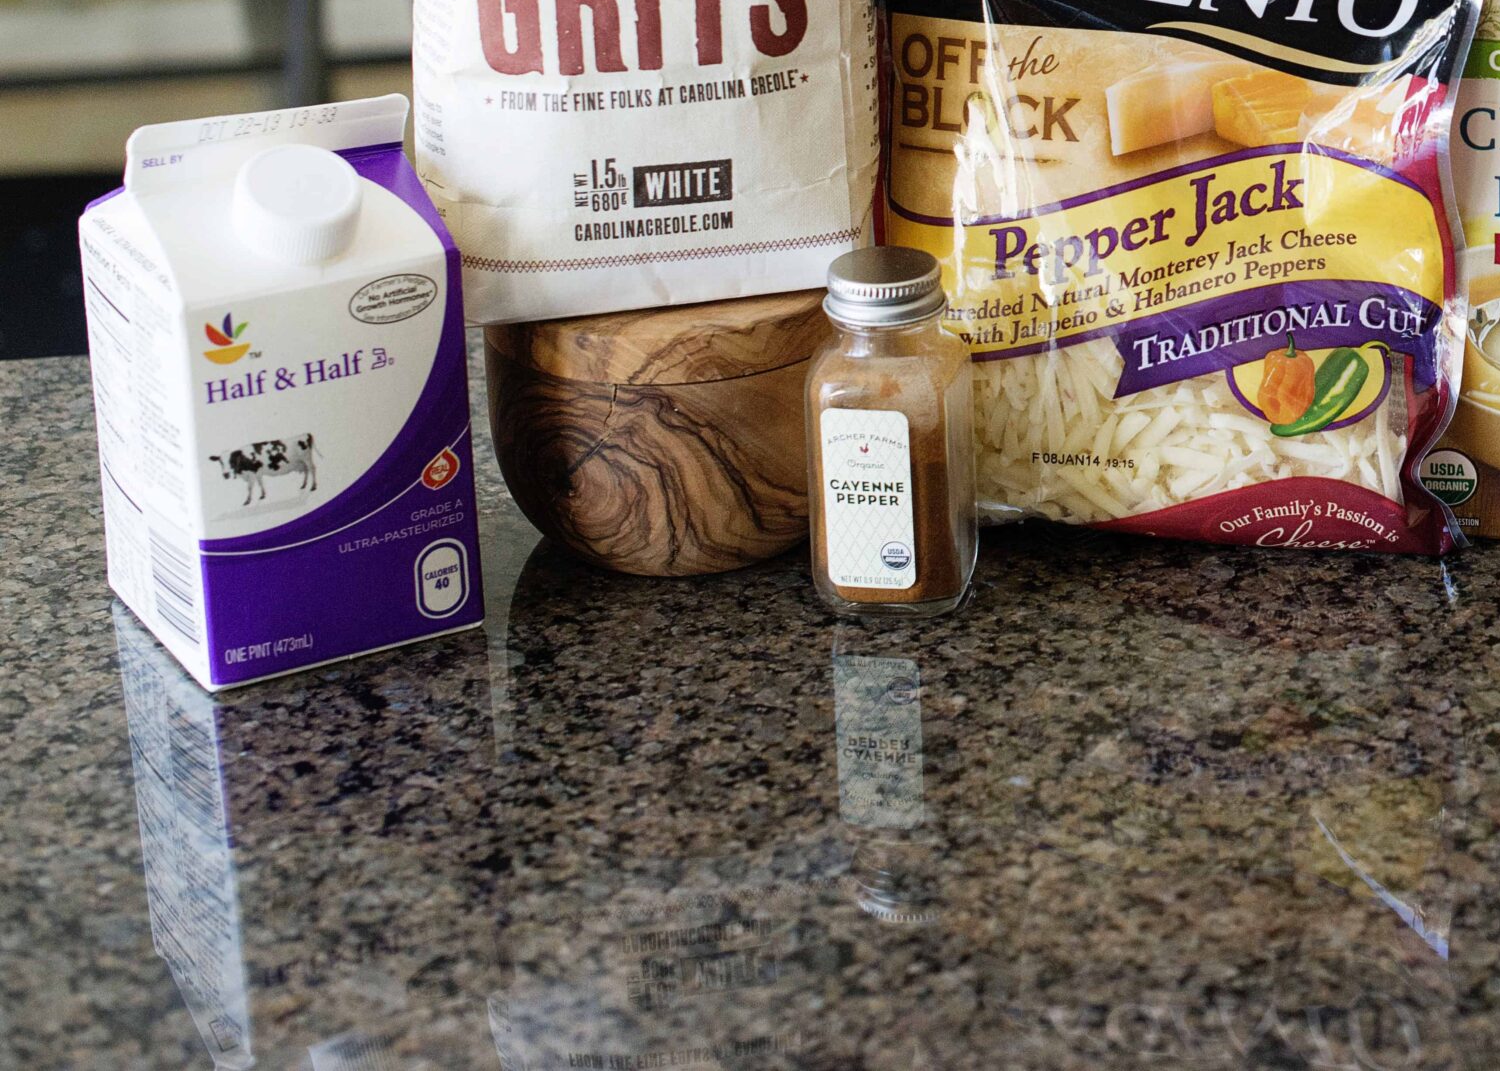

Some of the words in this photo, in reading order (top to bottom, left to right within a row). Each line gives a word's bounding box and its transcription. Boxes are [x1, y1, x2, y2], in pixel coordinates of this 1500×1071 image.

[902, 33, 998, 84] OFF
[1007, 35, 1060, 82] the
[501, 90, 538, 111] FROM
[542, 92, 568, 112] THE
[574, 89, 605, 111] FINE
[611, 87, 652, 109] FOLKS
[658, 88, 673, 106] AT
[680, 79, 746, 103] CAROLINA
[142, 158, 166, 169] SELL
[170, 154, 183, 165] BY
[573, 173, 588, 187] WT
[645, 167, 720, 200] WHITE
[574, 191, 589, 207] NET
[574, 211, 733, 241] CAROLINACREOLE.COM
[989, 204, 1175, 284] Pepper
[1185, 160, 1306, 245] Jack
[944, 294, 1024, 322] hredded
[1118, 247, 1219, 290] Monterey
[1225, 234, 1272, 266] Jack
[1280, 229, 1358, 249] Cheese
[960, 322, 1004, 346] with
[1011, 309, 1098, 344] Jalapeño
[1105, 298, 1125, 318] &
[1133, 270, 1236, 314] Habanero
[1244, 255, 1326, 283] Peppers
[1134, 302, 1350, 371] TRADITIONAL
[1359, 296, 1428, 341] CUT
[205, 370, 267, 404] Half
[274, 367, 296, 391] &
[304, 350, 363, 385] Half
[827, 433, 866, 445] ARCHER
[847, 460, 885, 470] Organic
[1032, 453, 1040, 463] F
[1043, 453, 1100, 466] 08JAN14
[1105, 458, 1134, 468] 19:15
[1430, 462, 1465, 477] USDA
[830, 479, 904, 493] CAYENNE
[1426, 481, 1469, 492] ORGANIC
[410, 502, 451, 522] GRADE
[454, 499, 463, 509] A
[837, 493, 899, 506] PEPPER
[339, 511, 464, 555] ULTRA-PASTEURIZED
[1219, 514, 1251, 533] Our
[1252, 499, 1322, 522] Family's
[1325, 502, 1385, 535] Passion
[1385, 528, 1400, 544] is
[425, 564, 459, 580] CALORIES
[434, 577, 450, 590] 40
[225, 648, 248, 665] ONE
[249, 644, 271, 661] PINT
[273, 635, 314, 657] (473mL)
